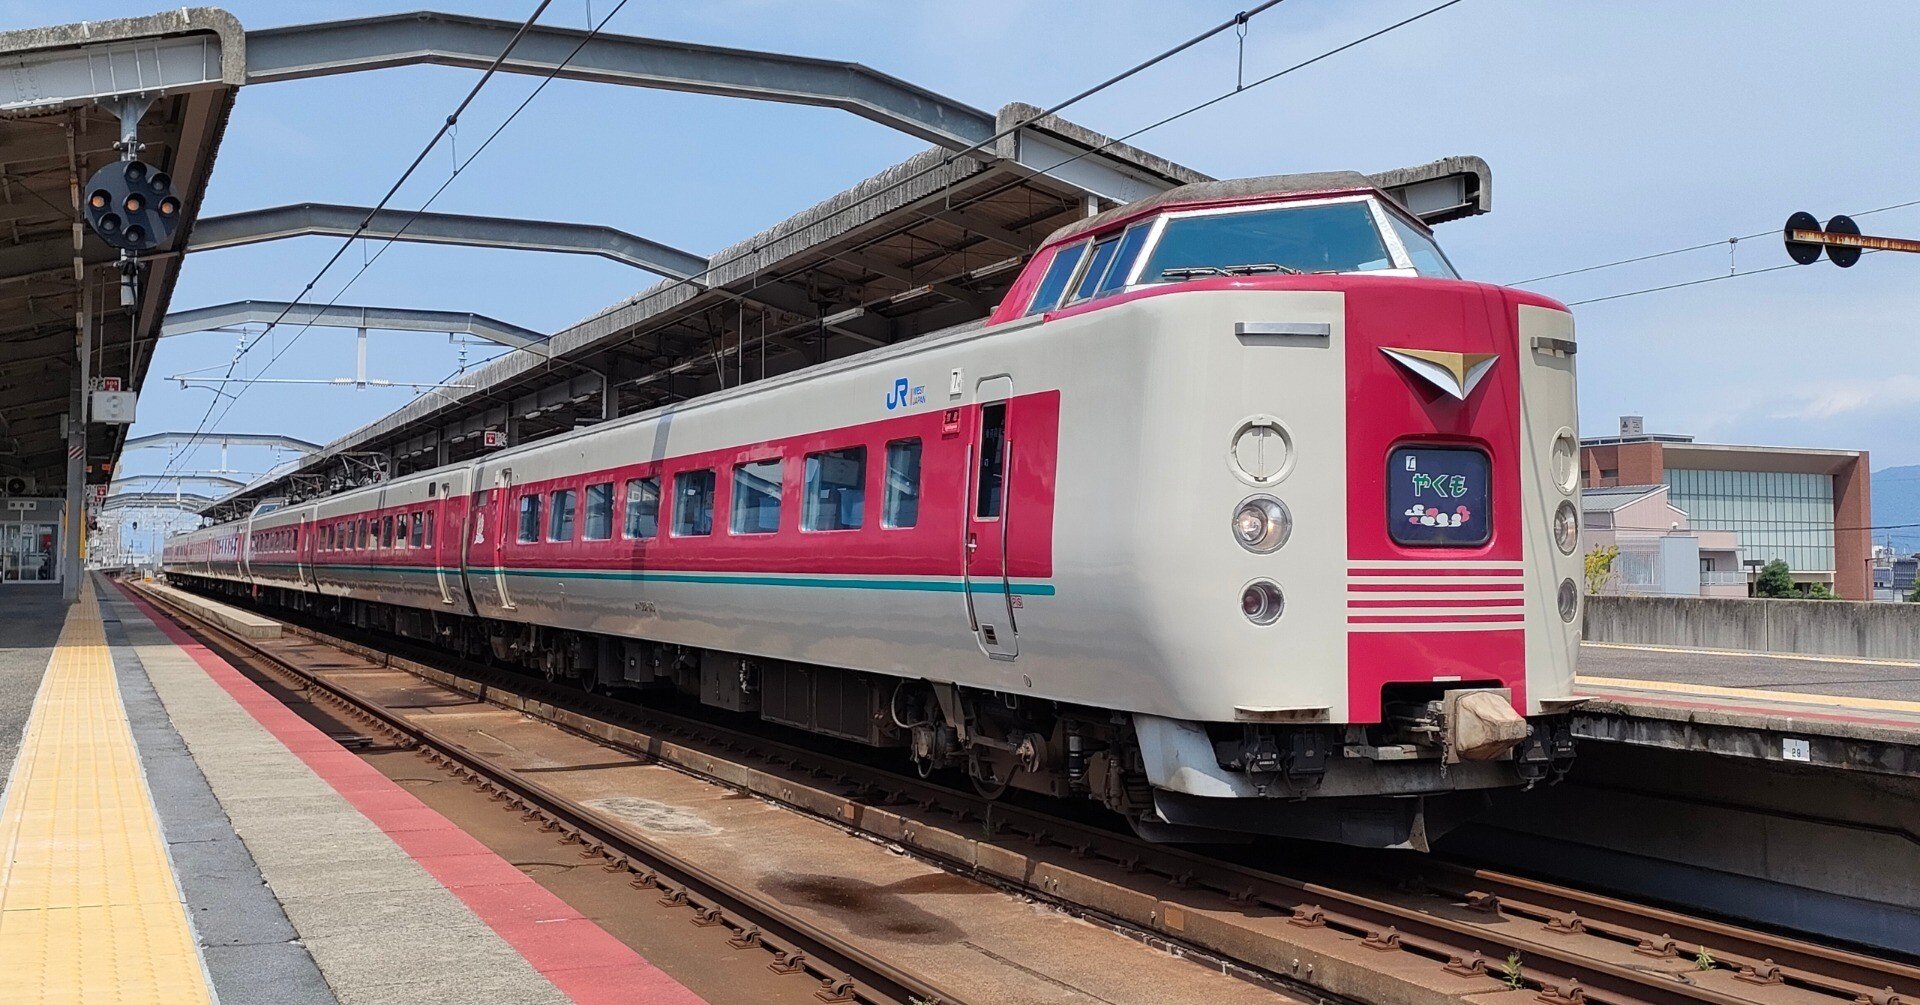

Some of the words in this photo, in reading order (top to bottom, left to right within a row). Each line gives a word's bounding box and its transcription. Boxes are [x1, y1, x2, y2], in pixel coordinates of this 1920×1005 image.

[913, 385, 926, 395] WEST
[952, 371, 959, 389] 7
[886, 377, 909, 410] JR
[912, 395, 926, 405] JAPAN
[106, 395, 123, 418] 3
[1412, 473, 1468, 497] やくも
